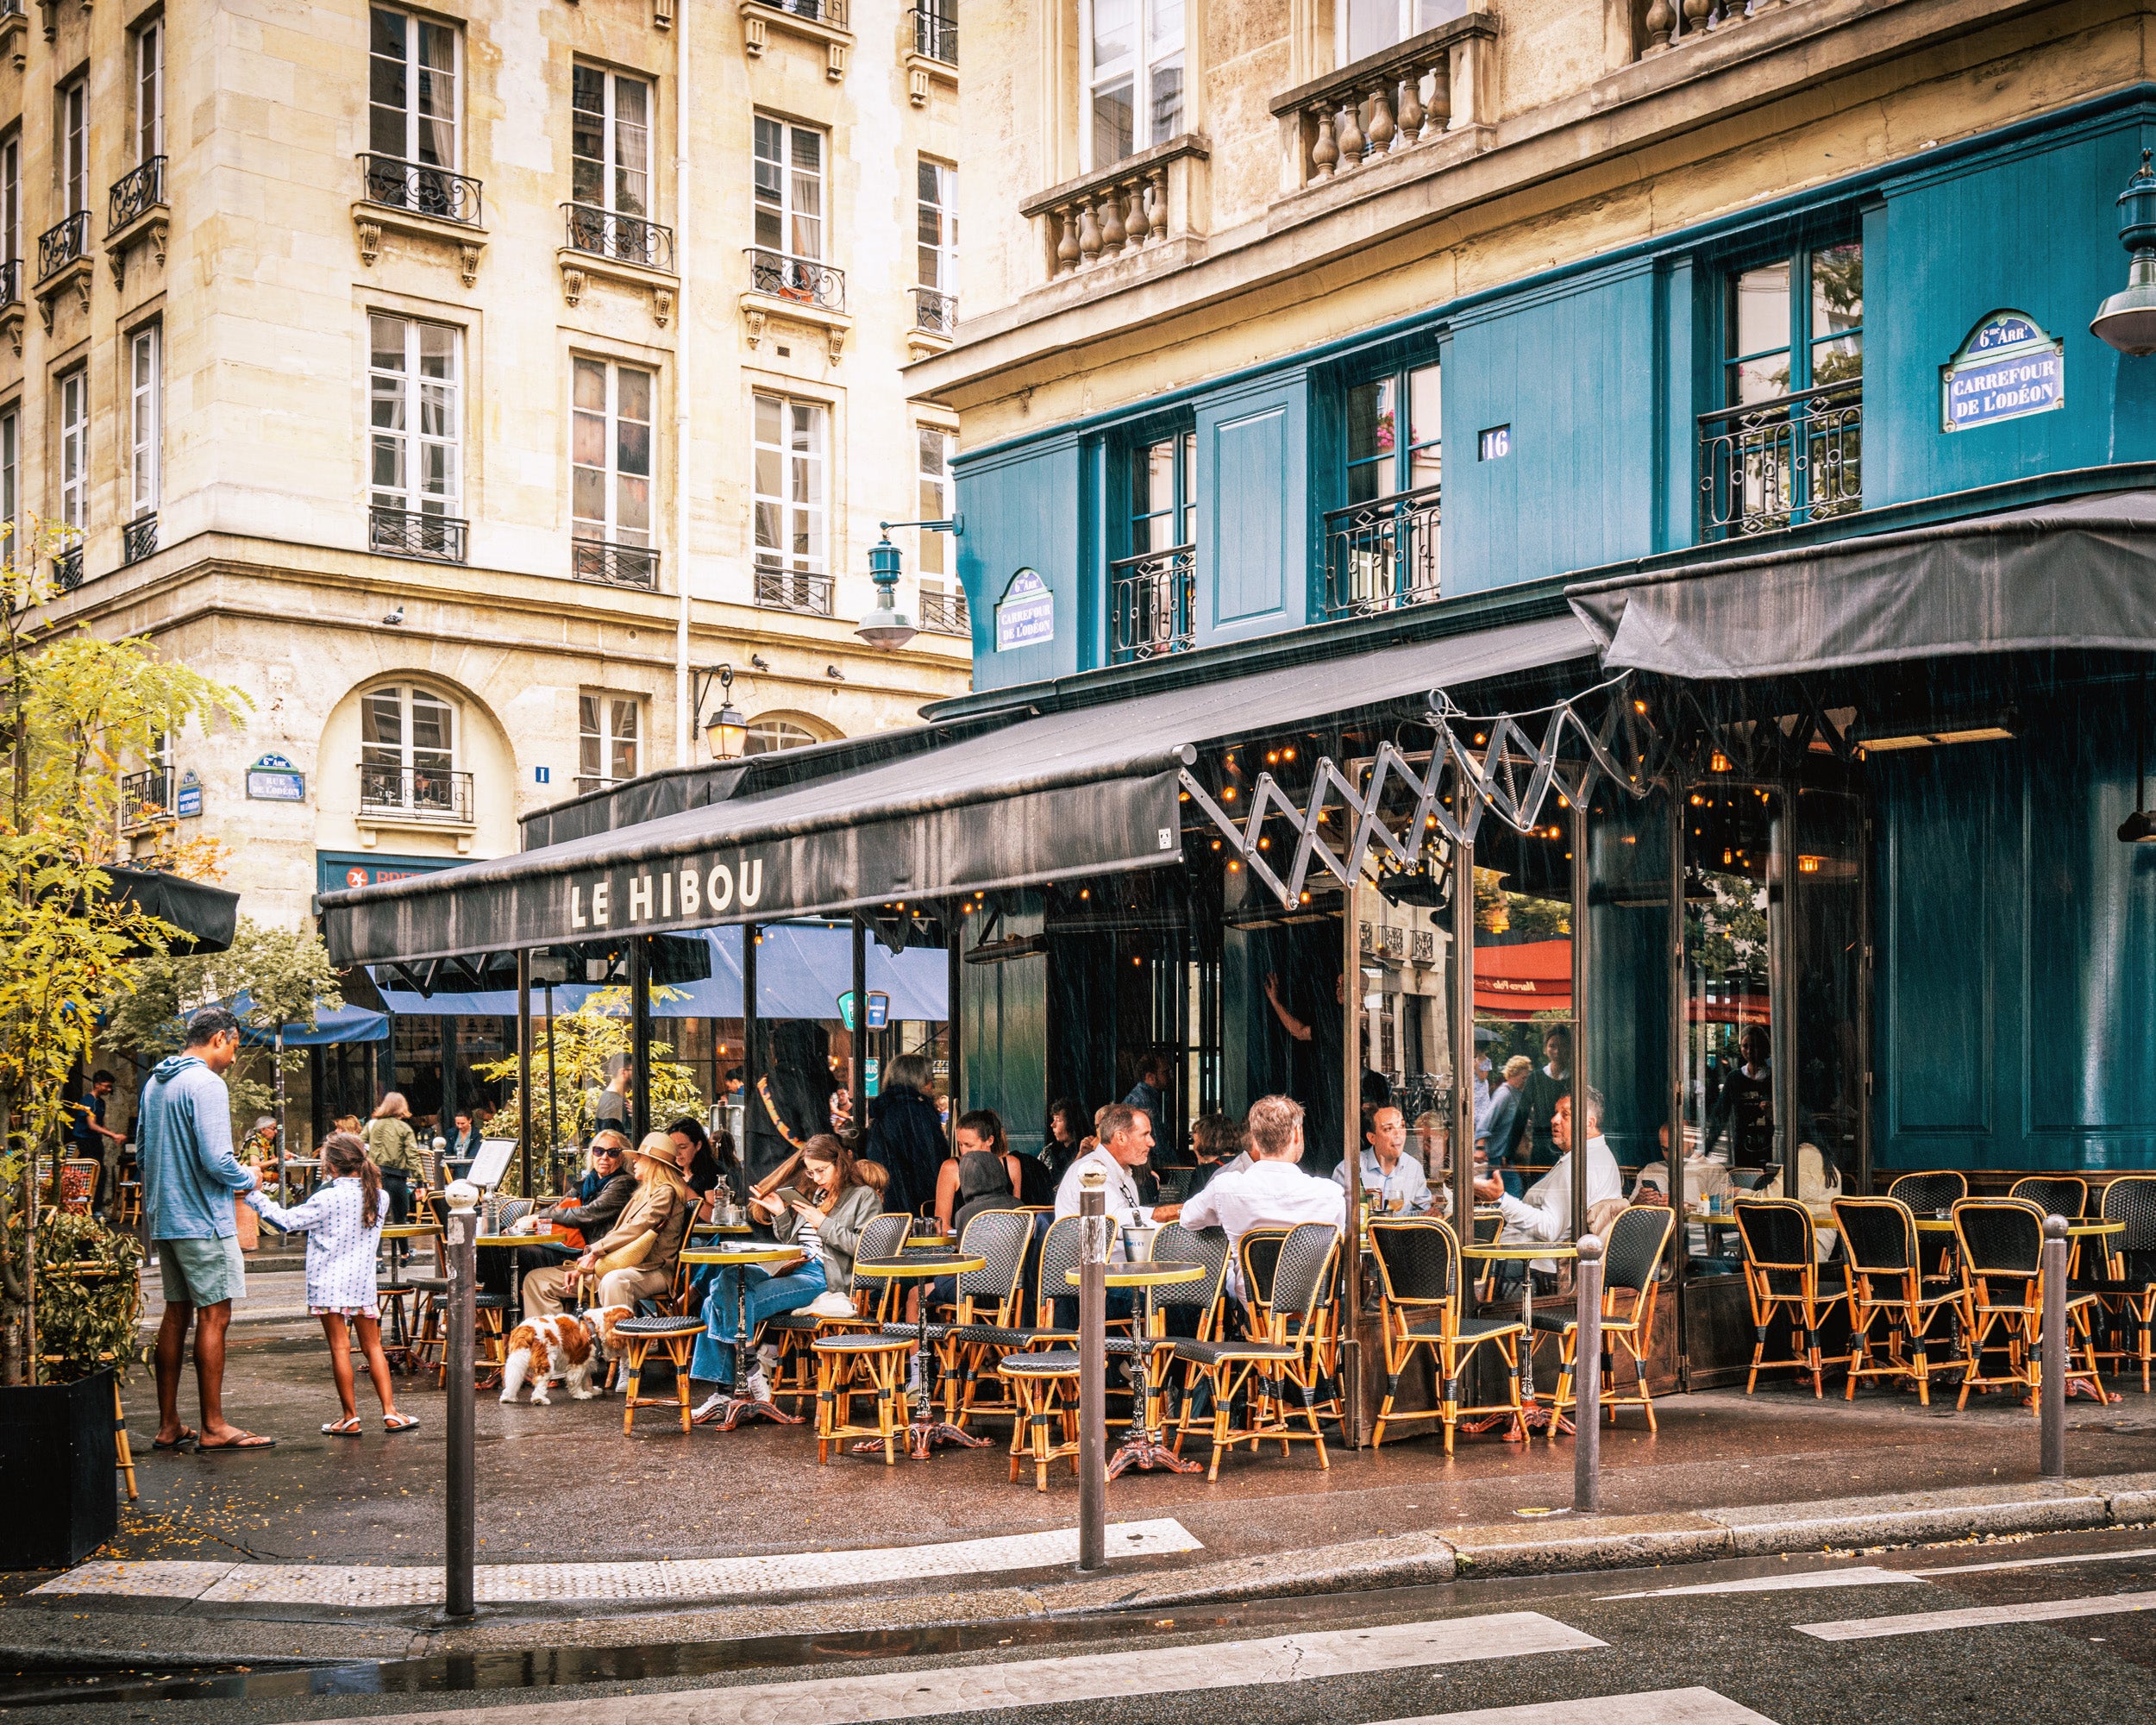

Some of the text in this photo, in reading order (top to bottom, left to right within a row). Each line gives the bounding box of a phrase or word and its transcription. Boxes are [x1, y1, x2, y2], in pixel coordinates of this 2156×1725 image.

[1953, 360, 2055, 397] CARREFOUR
[1956, 382, 2054, 417] DE L'ODÉON
[1486, 430, 1508, 460] 16
[1001, 604, 1051, 625] CARREFOUR
[1003, 619, 1050, 640] DE L'ODÉON
[266, 777, 285, 786] RUE
[570, 859, 762, 929] LE HIBOU
